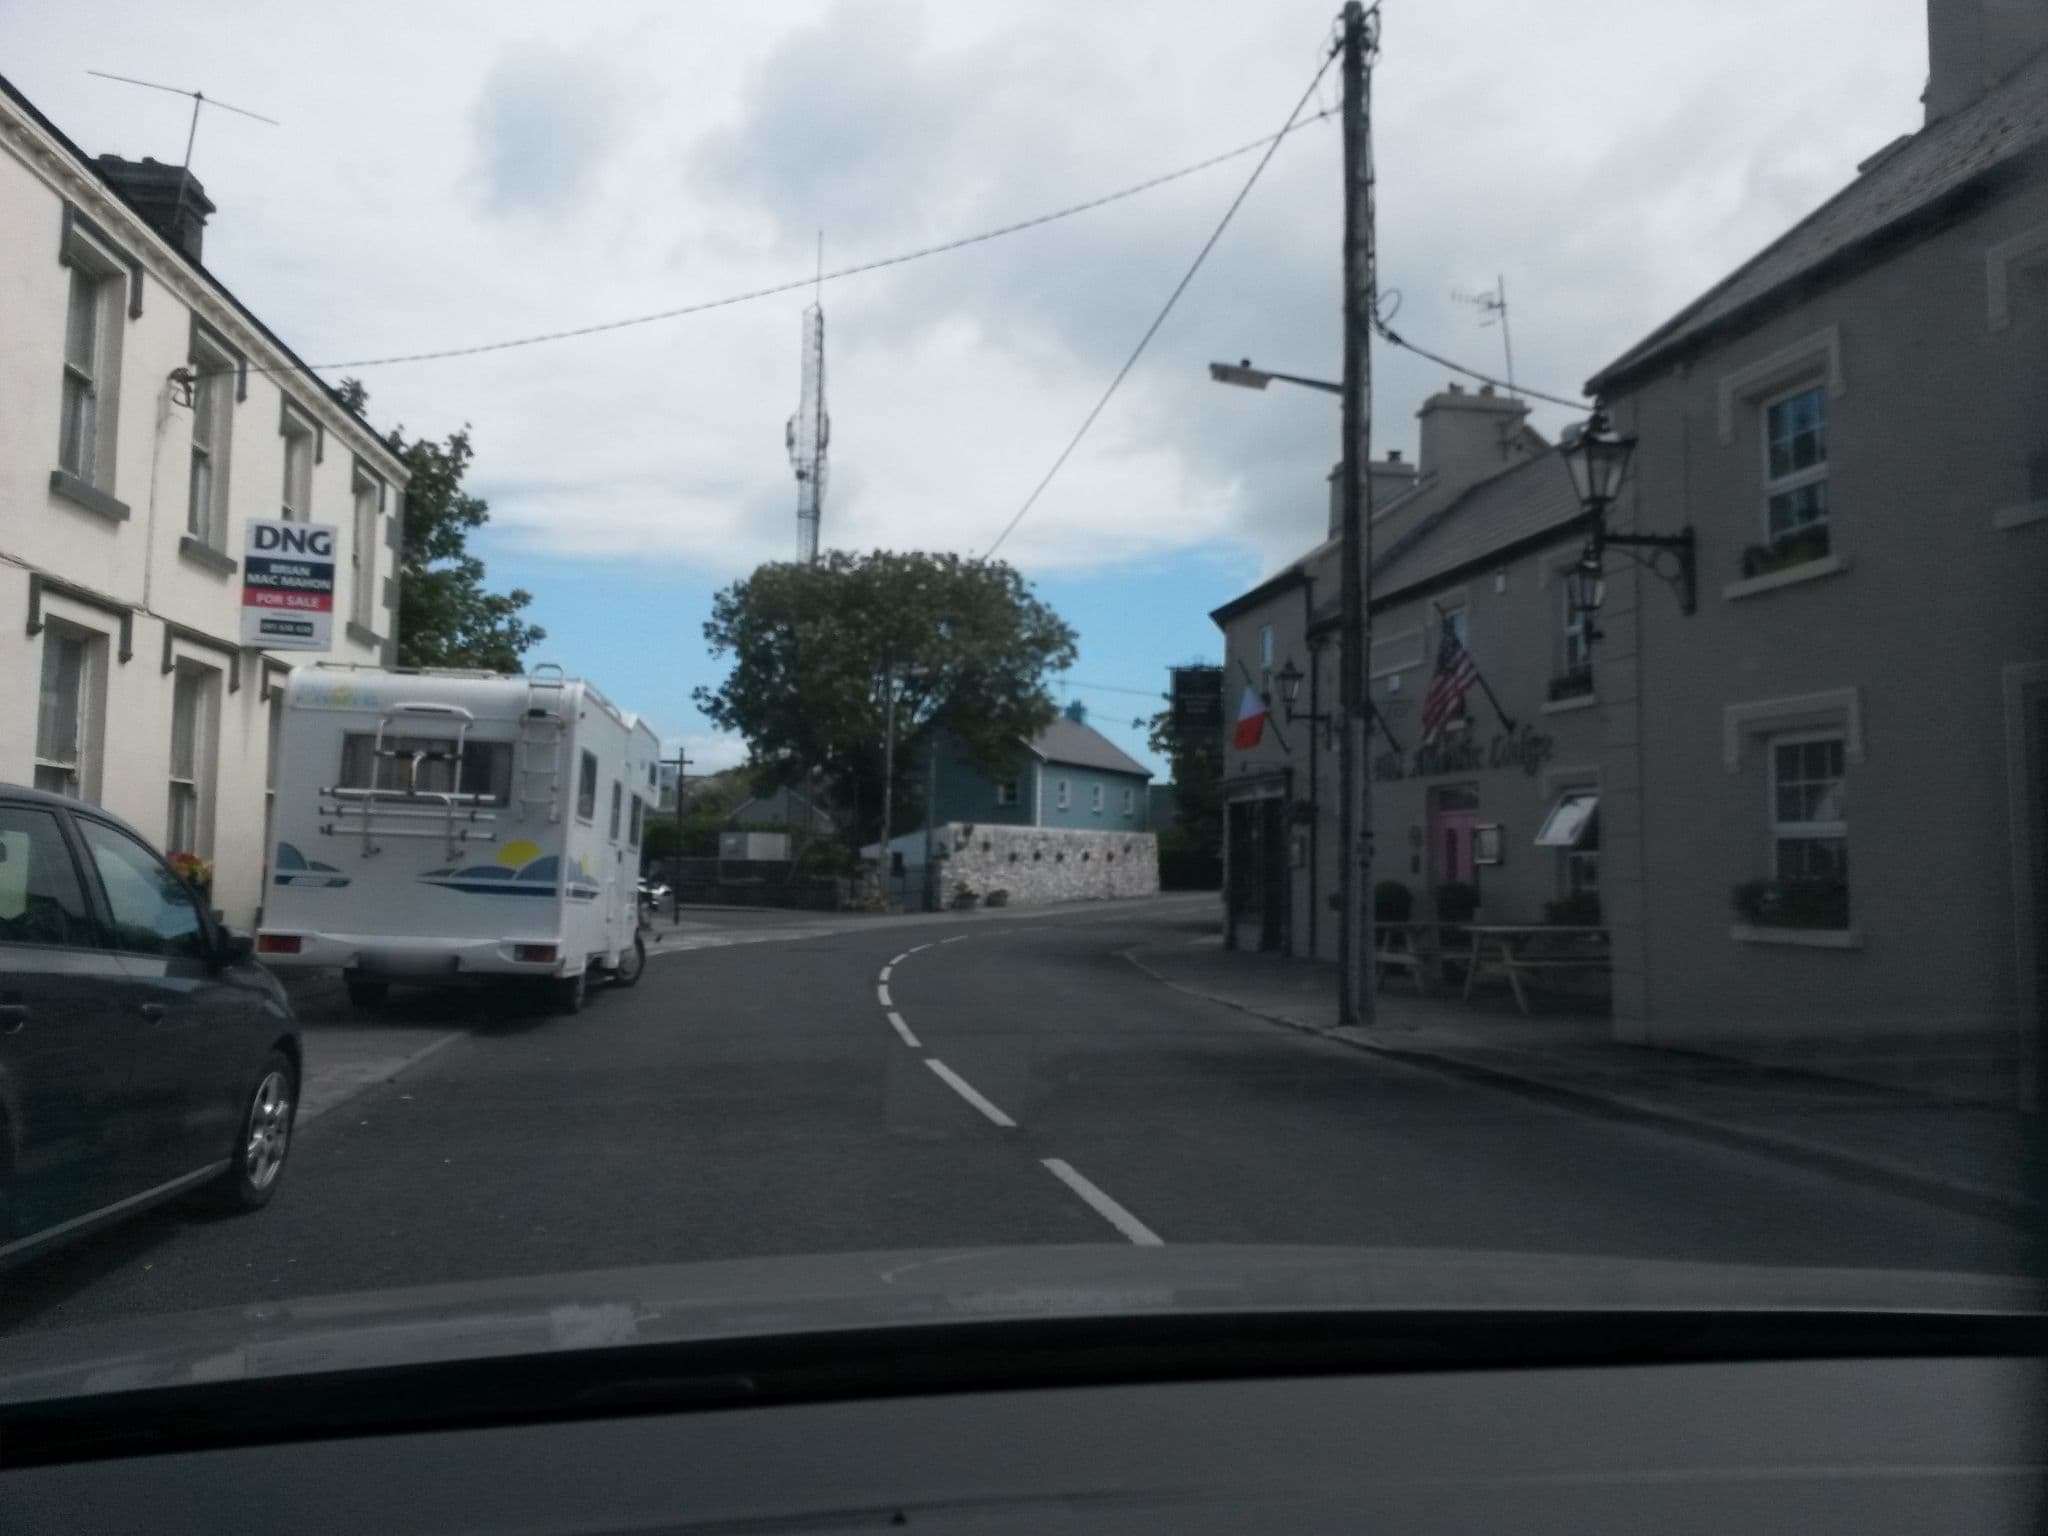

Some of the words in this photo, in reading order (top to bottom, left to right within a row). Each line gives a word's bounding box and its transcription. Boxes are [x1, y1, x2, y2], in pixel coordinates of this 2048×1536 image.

[254, 524, 332, 556] DNG
[247, 573, 278, 585] MAC
[256, 593, 284, 606] FOR
[286, 596, 320, 609] SALE
